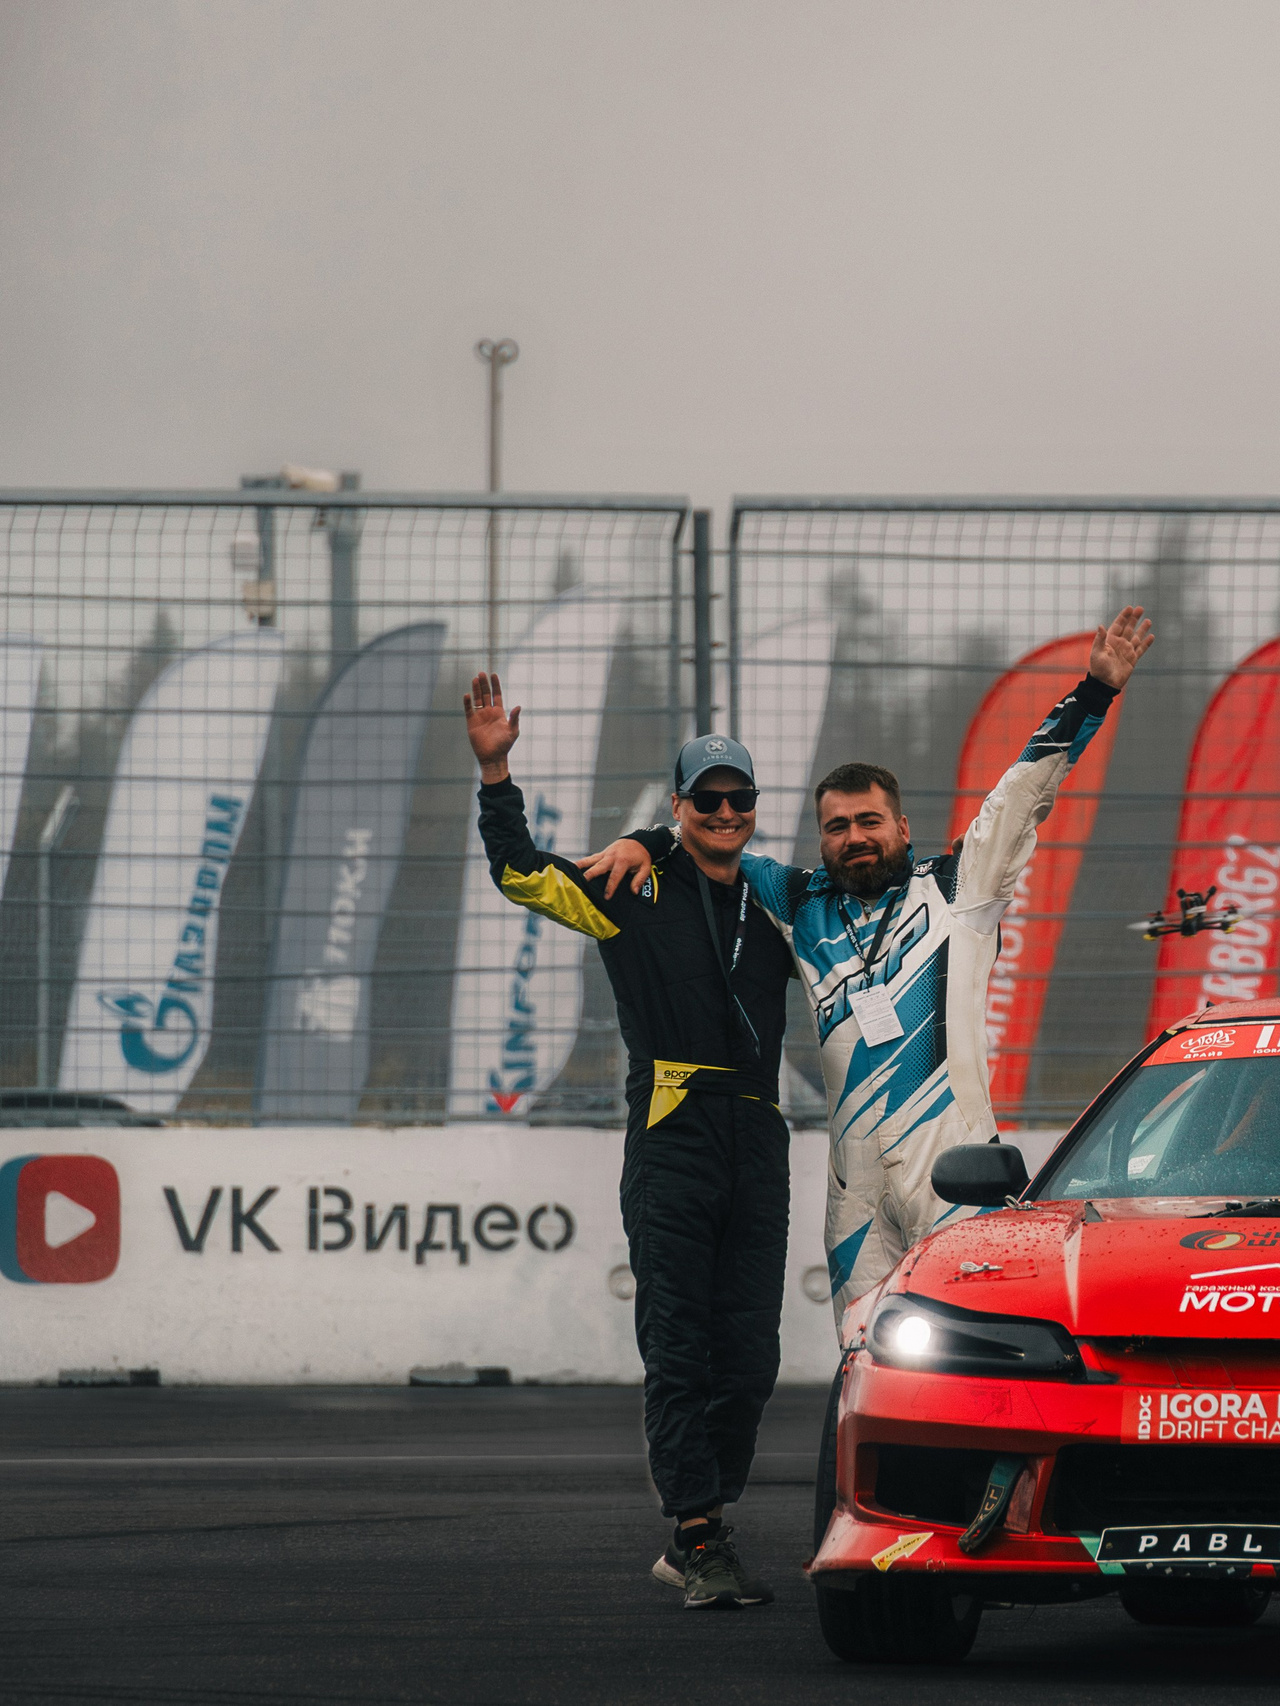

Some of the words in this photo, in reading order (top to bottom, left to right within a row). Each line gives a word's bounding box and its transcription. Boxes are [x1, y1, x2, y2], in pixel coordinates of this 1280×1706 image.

[166, 794, 243, 994] ГАЗПРОМ
[1183, 1051, 1223, 1059] ДРАЙВ
[663, 1069, 692, 1080] spar
[163, 1186, 282, 1253] VK
[307, 1186, 577, 1266] Видео
[1185, 1283, 1257, 1293] гаражный
[1138, 1395, 1152, 1440] IDDC
[1159, 1393, 1267, 1419] IGORA
[1158, 1420, 1229, 1440] DRIFT
